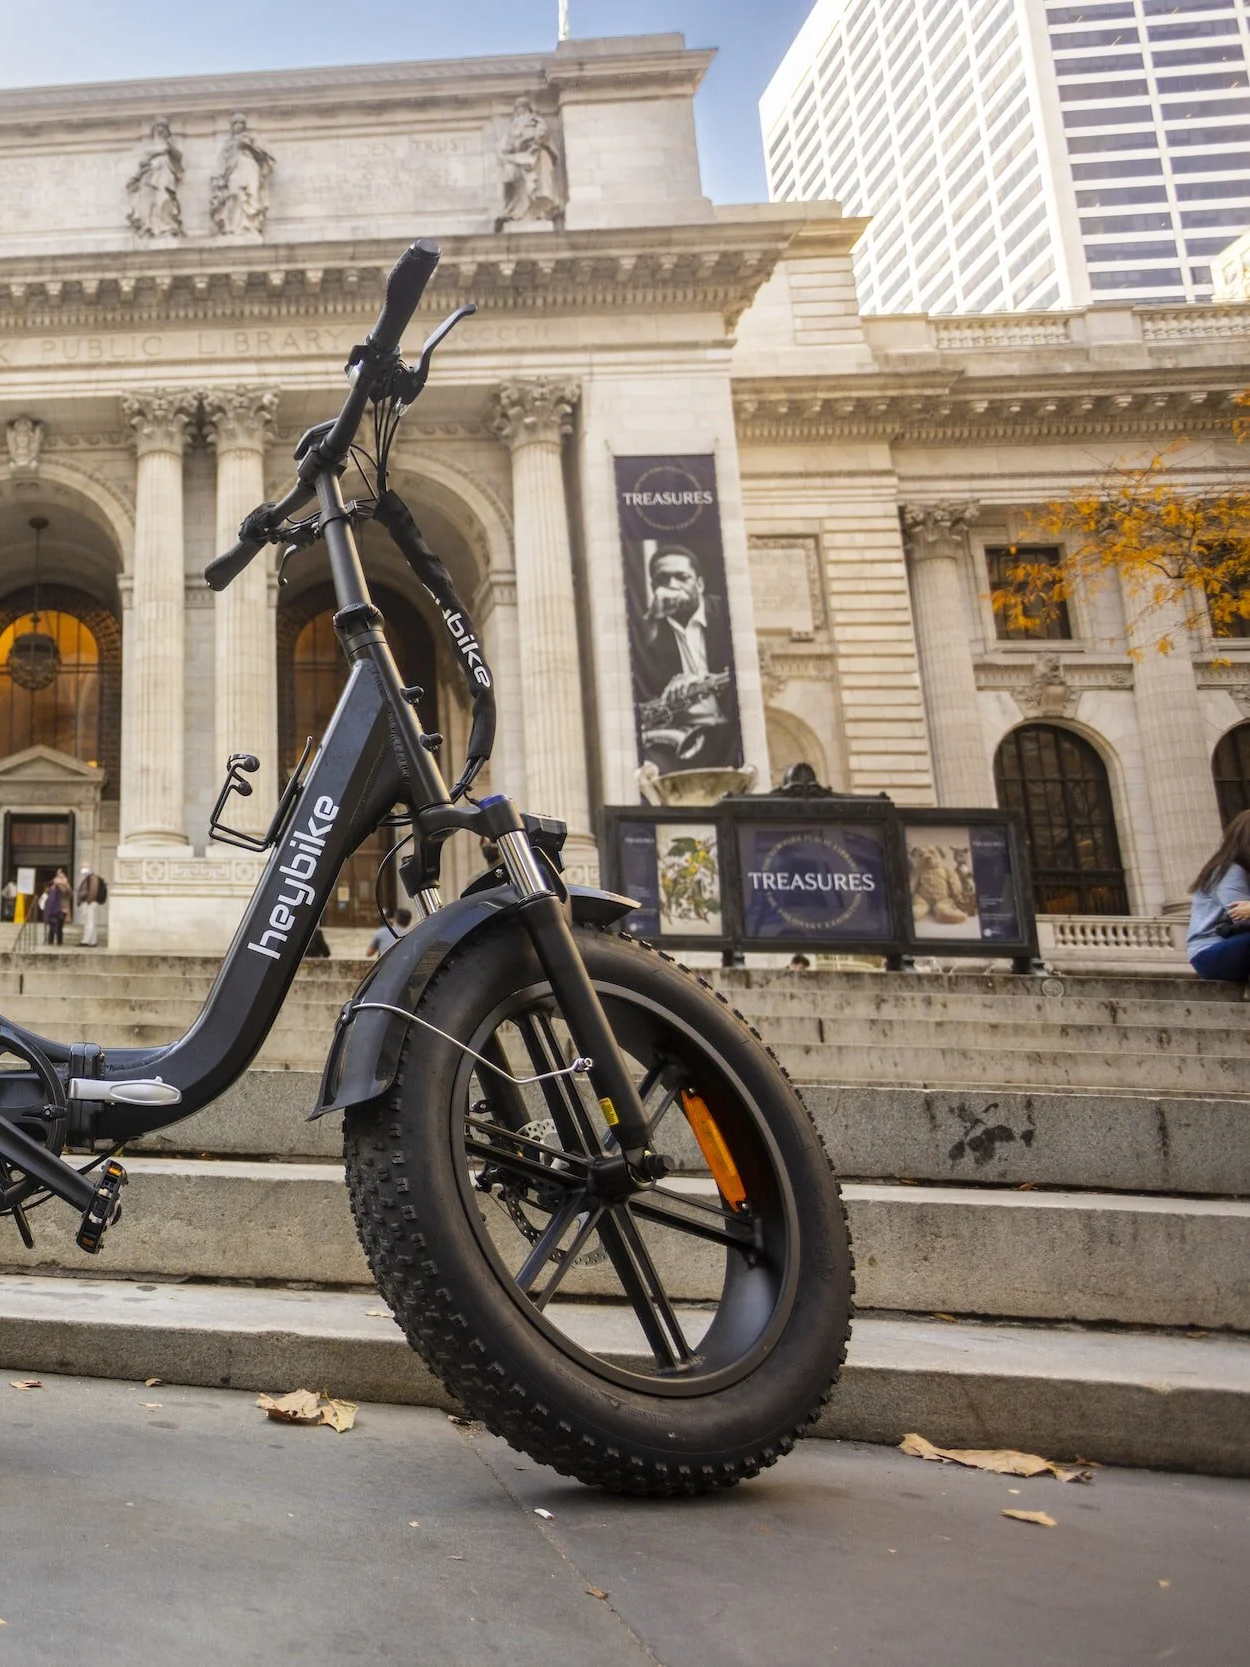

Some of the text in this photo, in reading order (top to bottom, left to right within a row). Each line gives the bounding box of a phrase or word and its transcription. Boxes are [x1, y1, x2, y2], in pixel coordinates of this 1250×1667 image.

[410, 136, 471, 154] TRUST
[40, 334, 164, 361] PUBLIC
[197, 328, 346, 356] LIBRARY
[621, 490, 714, 507] TREASURES
[247, 795, 340, 960] heybike
[748, 871, 876, 892] TREASURES
